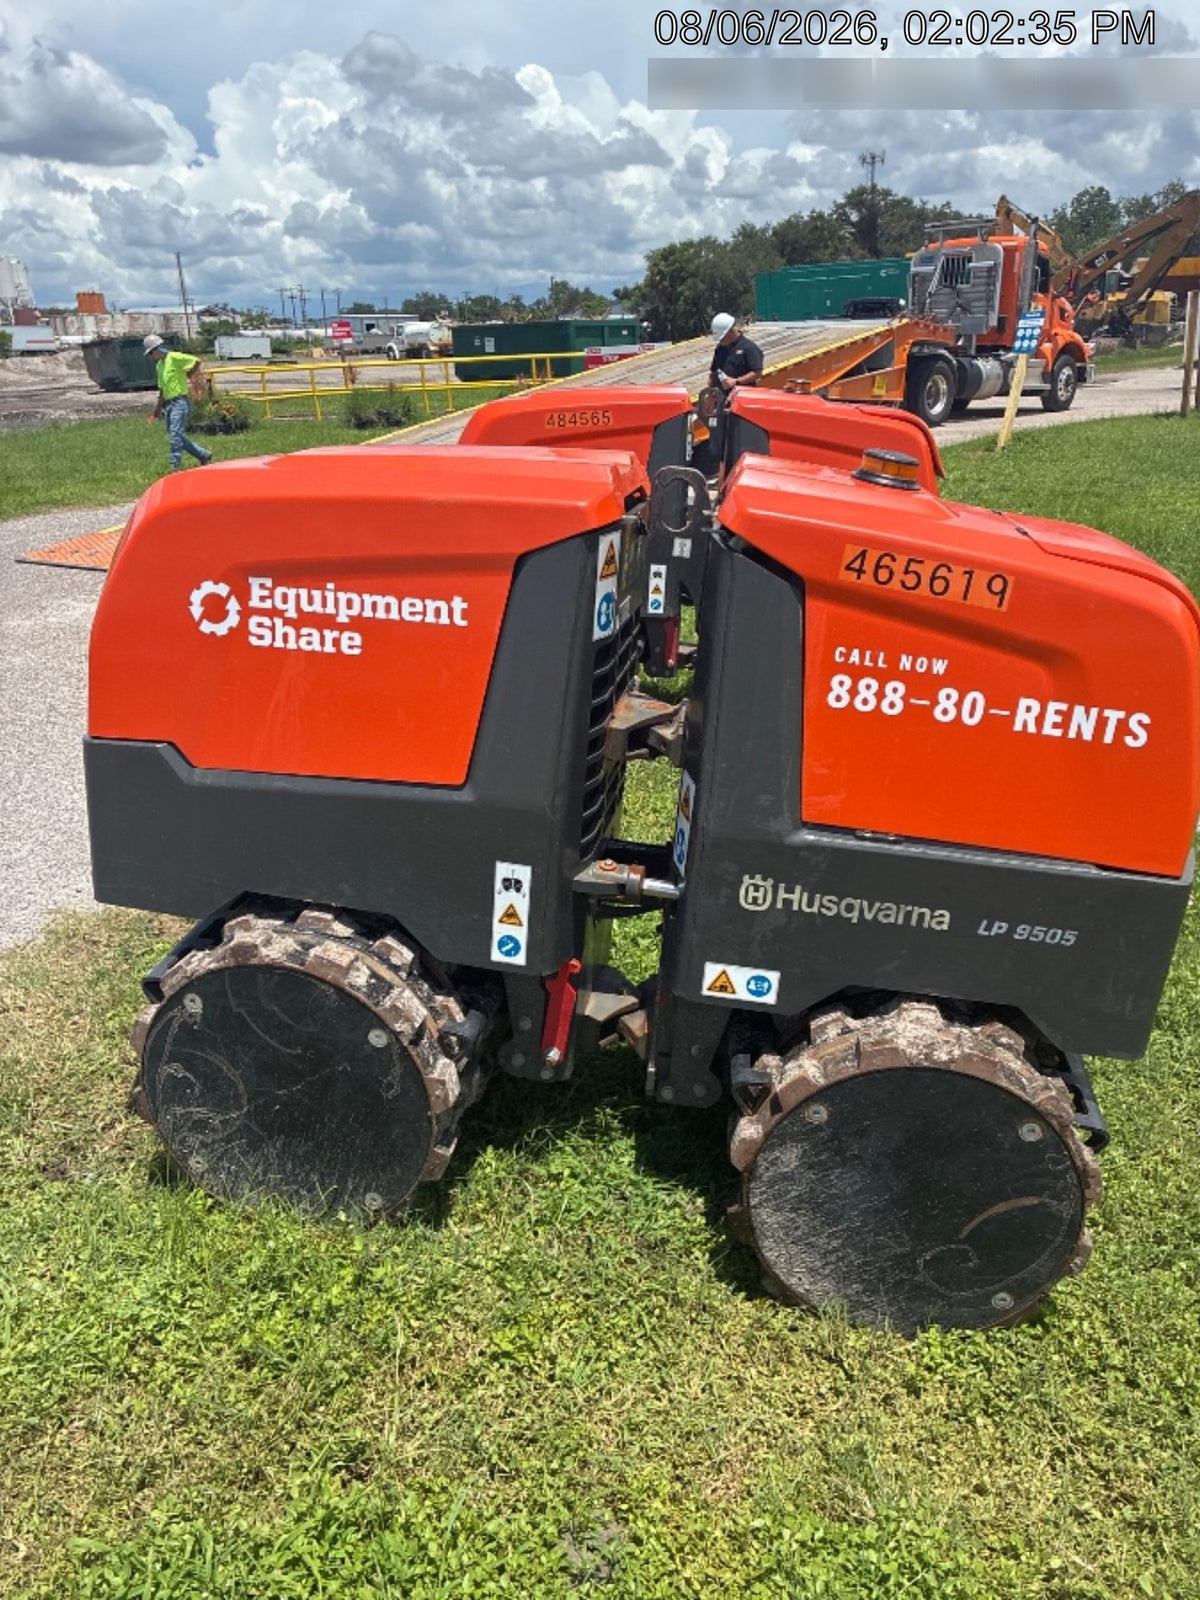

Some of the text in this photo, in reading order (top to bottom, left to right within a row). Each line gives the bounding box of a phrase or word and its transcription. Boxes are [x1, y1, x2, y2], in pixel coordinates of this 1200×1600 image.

[546, 410, 612, 428] 484565
[843, 547, 1010, 609] 465619
[248, 576, 469, 627] Equipment
[248, 615, 363, 655] Share
[834, 646, 949, 676] CALL NOW
[826, 673, 1152, 749] 888-80-RENTS
[775, 882, 951, 931] Husqvarna
[977, 918, 1078, 947] LP 9505
